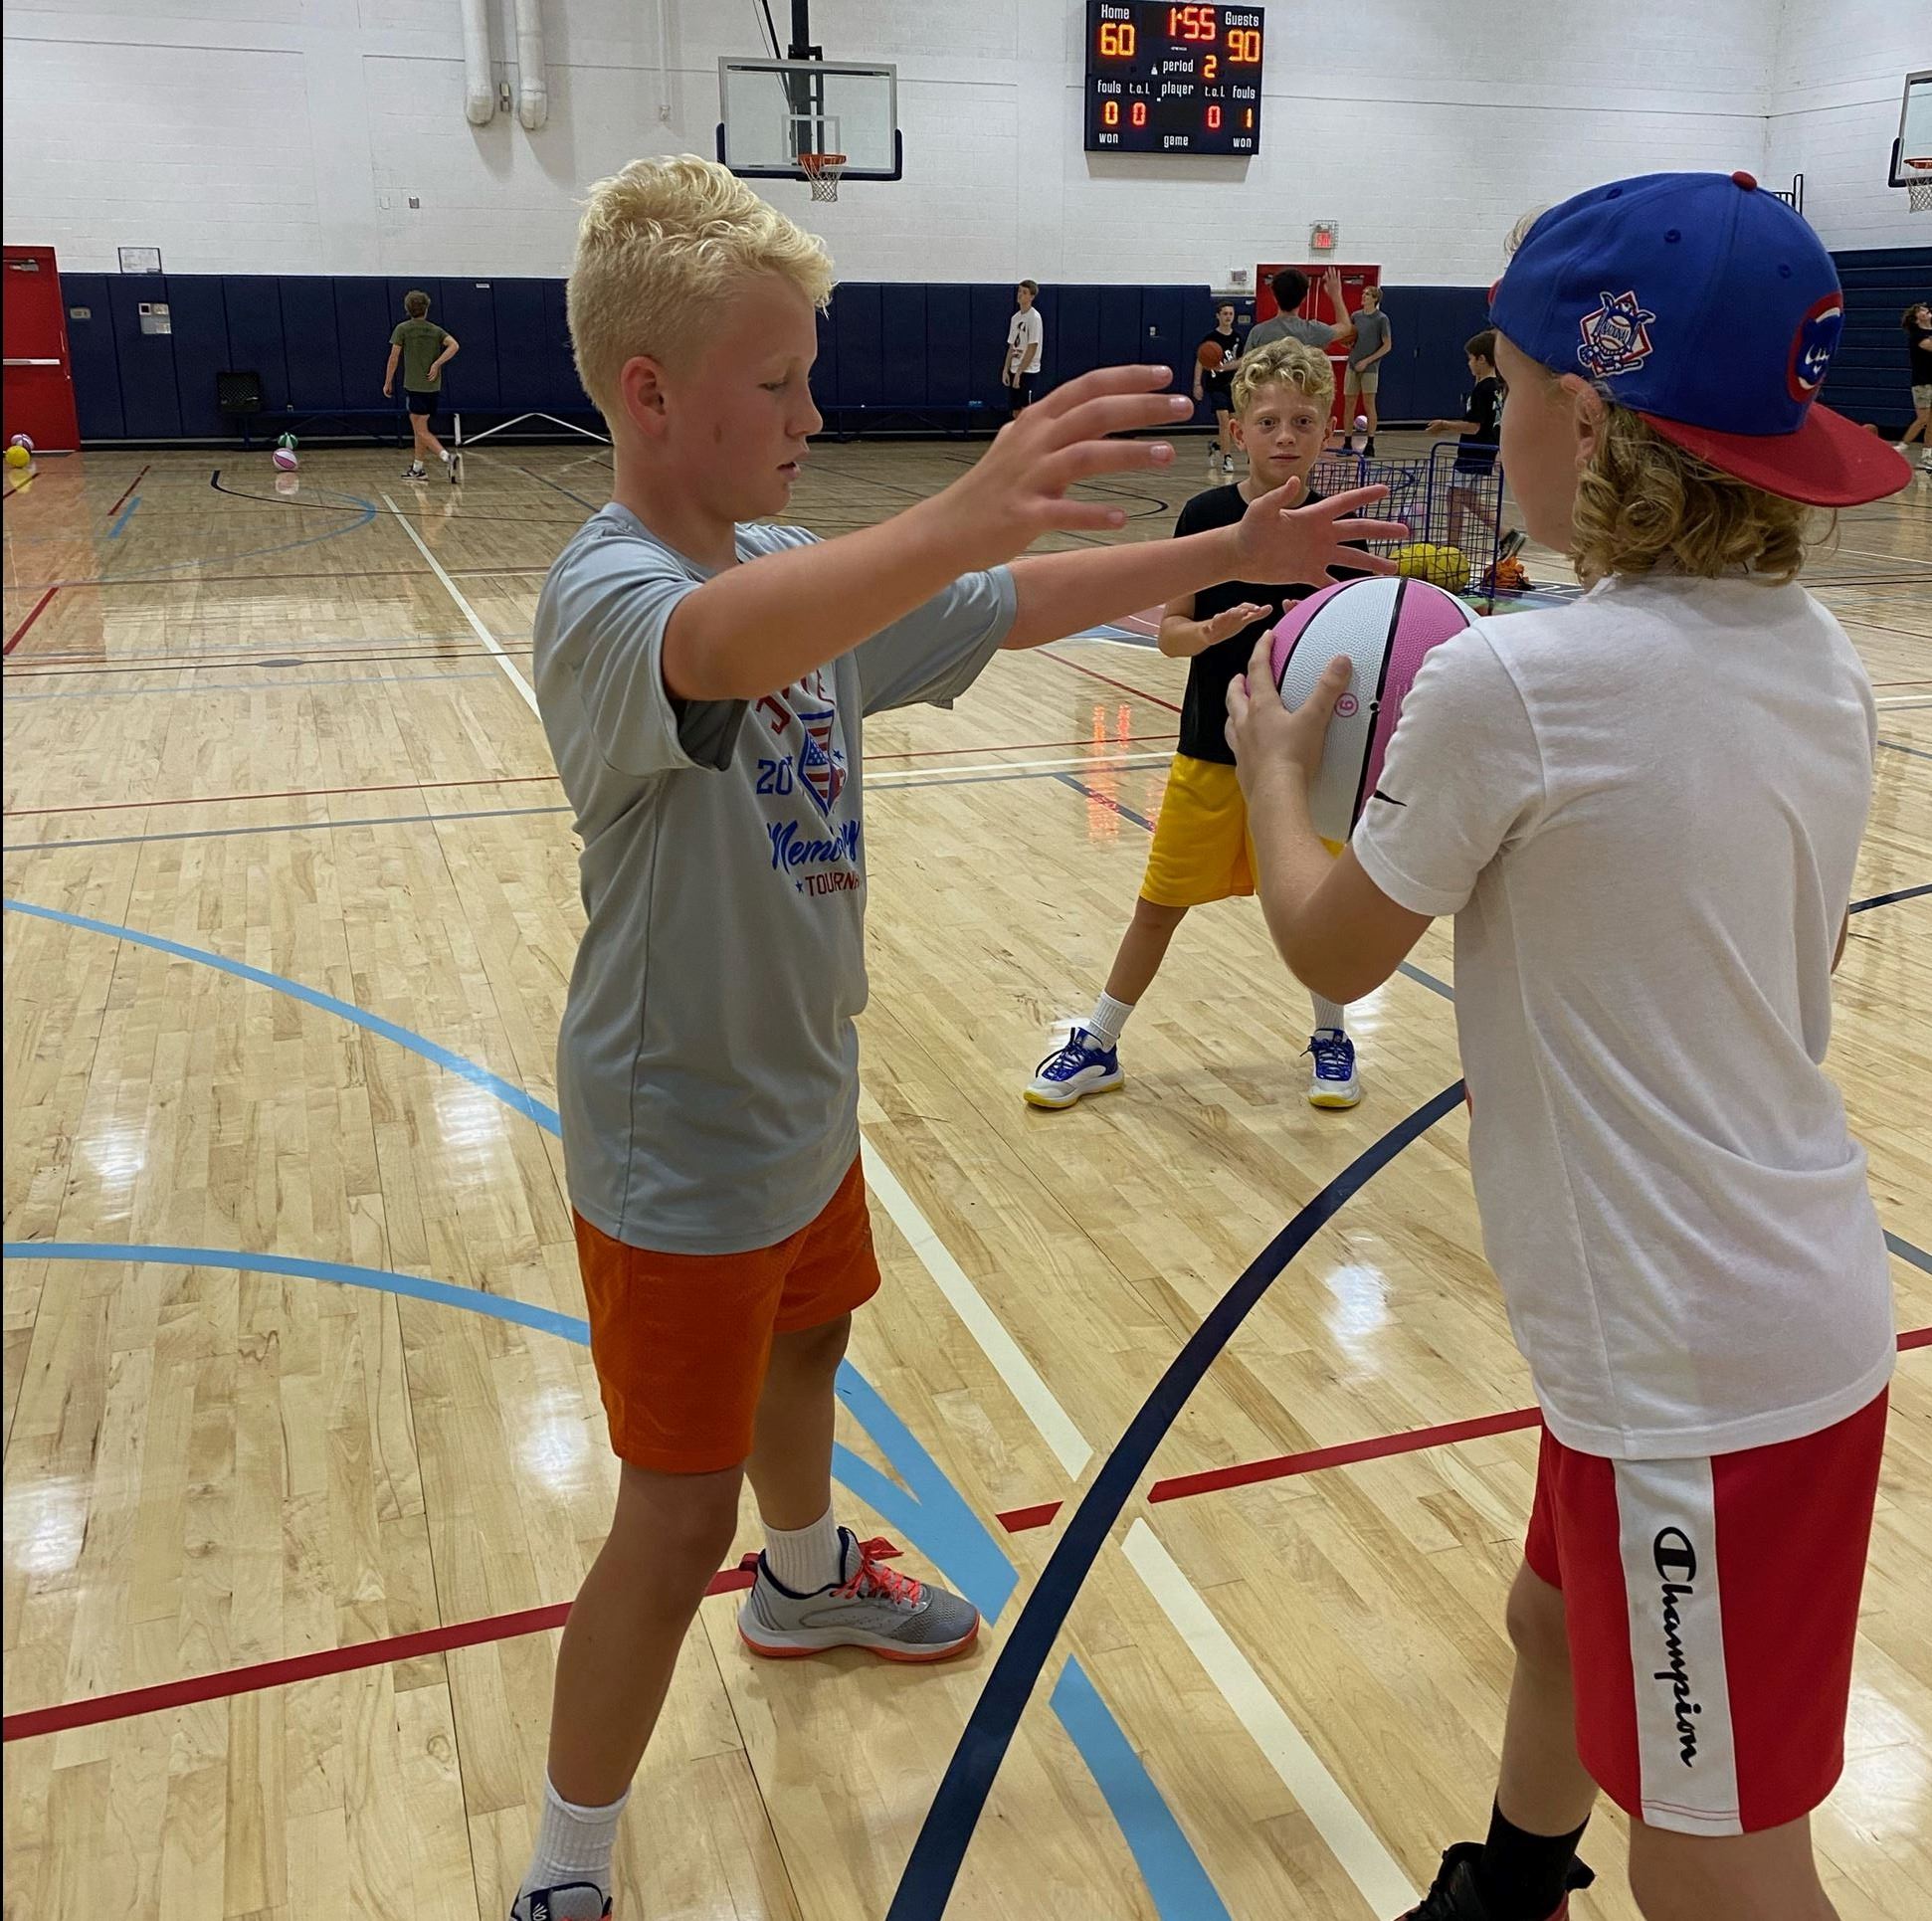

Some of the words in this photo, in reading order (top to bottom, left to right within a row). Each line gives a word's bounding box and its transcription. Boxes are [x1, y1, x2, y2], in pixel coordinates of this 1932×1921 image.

[1100, 4, 1130, 20] Home
[1225, 11, 1259, 27] Guests
[1168, 6, 1217, 41] 1:55
[1100, 22, 1136, 57] 60
[1228, 29, 1260, 63] 90
[1162, 59, 1194, 75] period
[1204, 54, 1218, 79] 2
[1097, 79, 1122, 95] fouls
[1161, 81, 1194, 98] player
[1232, 85, 1256, 99] fouls
[1104, 100, 1119, 125] 0
[1132, 101, 1147, 126] 0
[1207, 104, 1222, 128] 0
[1246, 106, 1254, 128] 1
[1098, 132, 1119, 144] won
[1163, 135, 1189, 147] game
[1233, 137, 1253, 148] won
[1652, 1526, 1702, 1768] Champion
